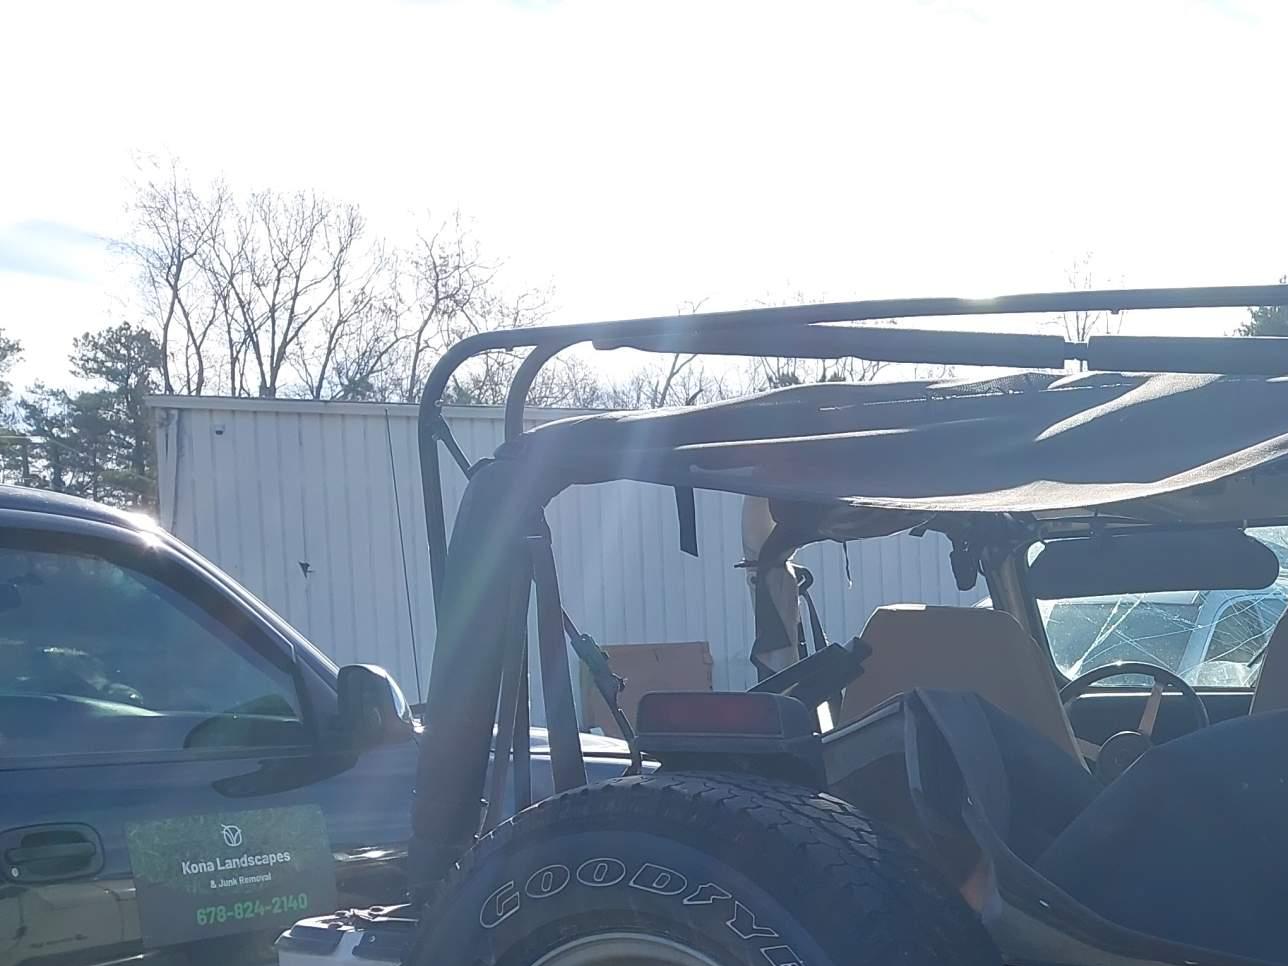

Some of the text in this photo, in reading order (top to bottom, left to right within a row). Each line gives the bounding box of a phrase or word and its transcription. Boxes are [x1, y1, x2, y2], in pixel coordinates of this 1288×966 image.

[181, 851, 291, 875] Kona Landscapes
[210, 872, 272, 889] & Junk Removal
[196, 893, 308, 926] 678-824-2140
